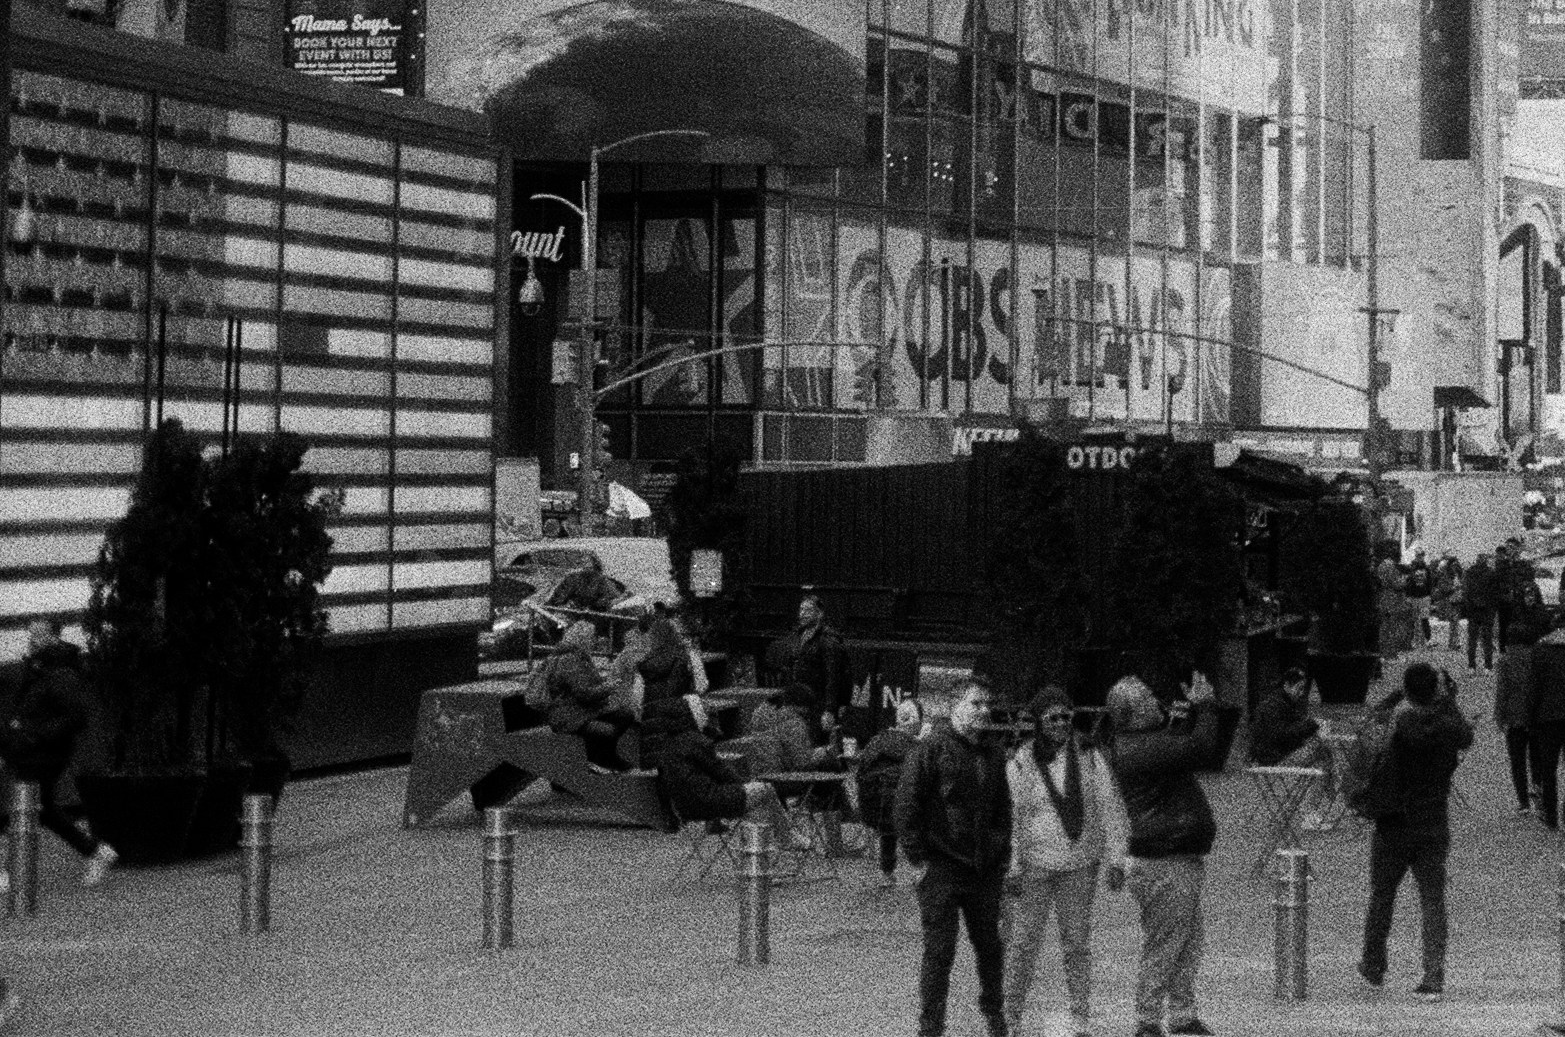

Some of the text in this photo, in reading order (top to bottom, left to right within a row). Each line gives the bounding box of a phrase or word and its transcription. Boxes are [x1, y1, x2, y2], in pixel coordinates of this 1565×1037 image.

[291, 13, 347, 33] Mama
[330, 37, 363, 49] YOUR
[298, 49, 335, 61] EVENT
[338, 49, 370, 61] WITH
